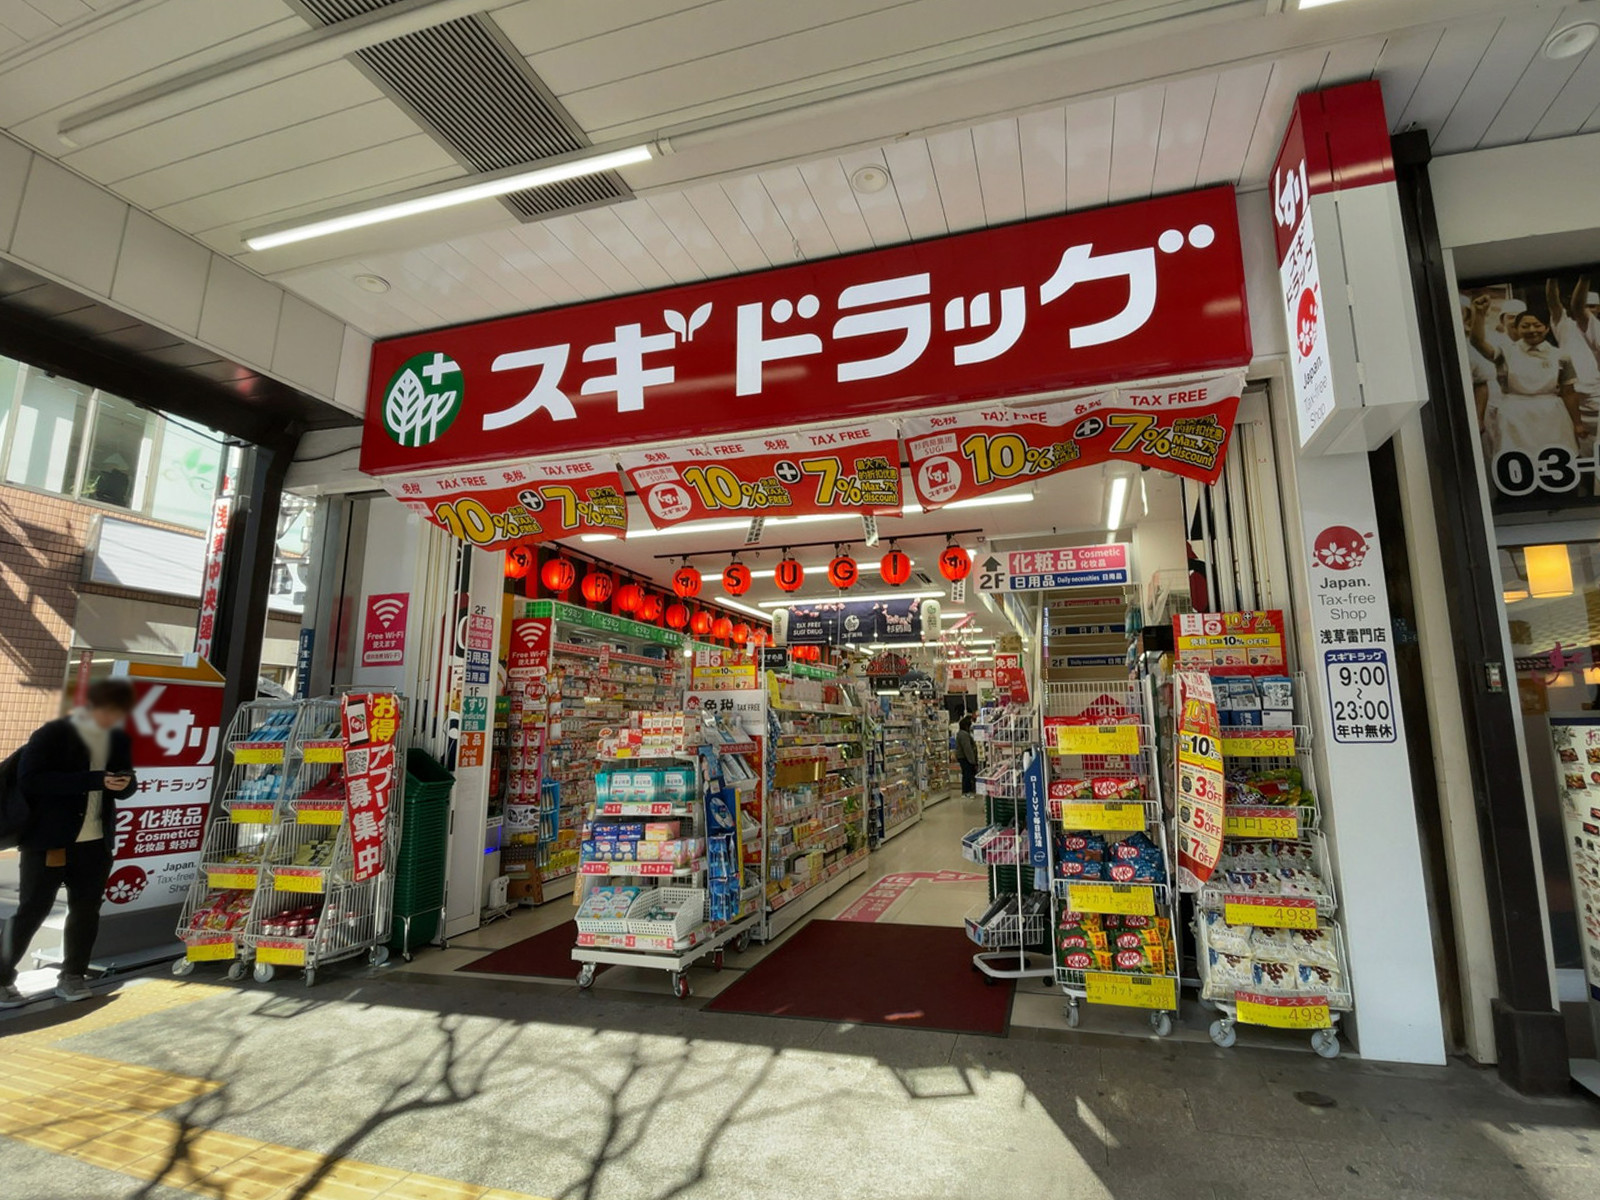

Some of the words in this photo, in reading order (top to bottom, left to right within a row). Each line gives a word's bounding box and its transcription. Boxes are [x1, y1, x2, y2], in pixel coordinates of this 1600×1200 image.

[1275, 159, 1308, 231] くすり
[481, 223, 1216, 432] スギドラッグ
[1130, 394, 1162, 407] TAX
[1168, 388, 1208, 403] FREE
[1310, 402, 1326, 429] Shop
[808, 432, 837, 446] TAX
[840, 428, 871, 441] FREE
[1108, 414, 1170, 456] 7%
[687, 446, 711, 457] TAX
[714, 444, 744, 456] FREE
[764, 439, 790, 451] 免税
[1172, 435, 1199, 450] Max.
[1200, 441, 1218, 455] 7%
[644, 452, 670, 463] 免税
[964, 434, 1052, 484] 10%
[1170, 447, 1214, 468] discount
[541, 465, 563, 476] TAX
[566, 462, 594, 473] FREE
[1497, 445, 1600, 491] 03-
[437, 479, 459, 490] TAX
[461, 476, 487, 488] FREE
[502, 470, 526, 483] 免税
[801, 457, 862, 505] 7%
[402, 483, 422, 495] 免税
[684, 466, 767, 509] 10%
[861, 481, 881, 492] Max.
[883, 482, 898, 492] 7%
[767, 494, 791, 504] FREE
[862, 491, 898, 504] discount
[540, 485, 602, 529] 7%
[436, 498, 520, 545] 10%
[519, 523, 541, 534] FREE
[1079, 548, 1121, 559] Cosmetic
[1012, 551, 1077, 574] 化粧品
[727, 567, 741, 588] S
[780, 564, 796, 585] U
[833, 560, 854, 581] G
[892, 554, 898, 575] I
[1102, 573, 1124, 582] 日用品
[980, 572, 1006, 590] 2F
[1015, 575, 1056, 589] 日用品
[1057, 576, 1071, 584] Daily
[1320, 577, 1371, 590] Japan.
[1317, 593, 1376, 606] Tax-free
[474, 604, 486, 615] 2F
[1330, 608, 1367, 621] Shop
[367, 632, 384, 640] Free
[385, 631, 405, 640] Wi-Fi
[469, 630, 492, 639] osmetic
[1320, 628, 1387, 645] 浅草雷門店
[512, 651, 529, 659] Free
[1327, 652, 1383, 662] スギドラッグ
[995, 657, 1018, 669] 免税
[1052, 659, 1064, 667] 2F
[1339, 666, 1386, 687] 9:00
[469, 686, 480, 697] 1F
[737, 703, 746, 711] TAX
[747, 703, 761, 711] FREE
[1334, 700, 1390, 721] 23:00
[132, 685, 220, 765] くすり
[370, 697, 395, 742] お得
[1337, 725, 1393, 739] 年中無休
[1252, 739, 1289, 751] 298
[137, 776, 212, 793] ギドラッグ
[1207, 789, 1222, 803] OFF
[138, 806, 203, 829] 化粧品
[1193, 809, 1214, 829] 5%
[348, 778, 379, 873] 募集中
[1204, 820, 1222, 835] OFF
[1258, 819, 1292, 832] 138
[135, 828, 200, 844] Cosmetics
[1190, 837, 1209, 858] 7%
[162, 861, 197, 872] Japan.
[1199, 853, 1214, 867] OFF
[157, 872, 195, 884] Tax-free
[1225, 895, 1317, 908] 当店オススメ
[1273, 908, 1312, 922] 498
[1236, 991, 1328, 1006] 当店オススメ
[1288, 1007, 1325, 1022] 498
